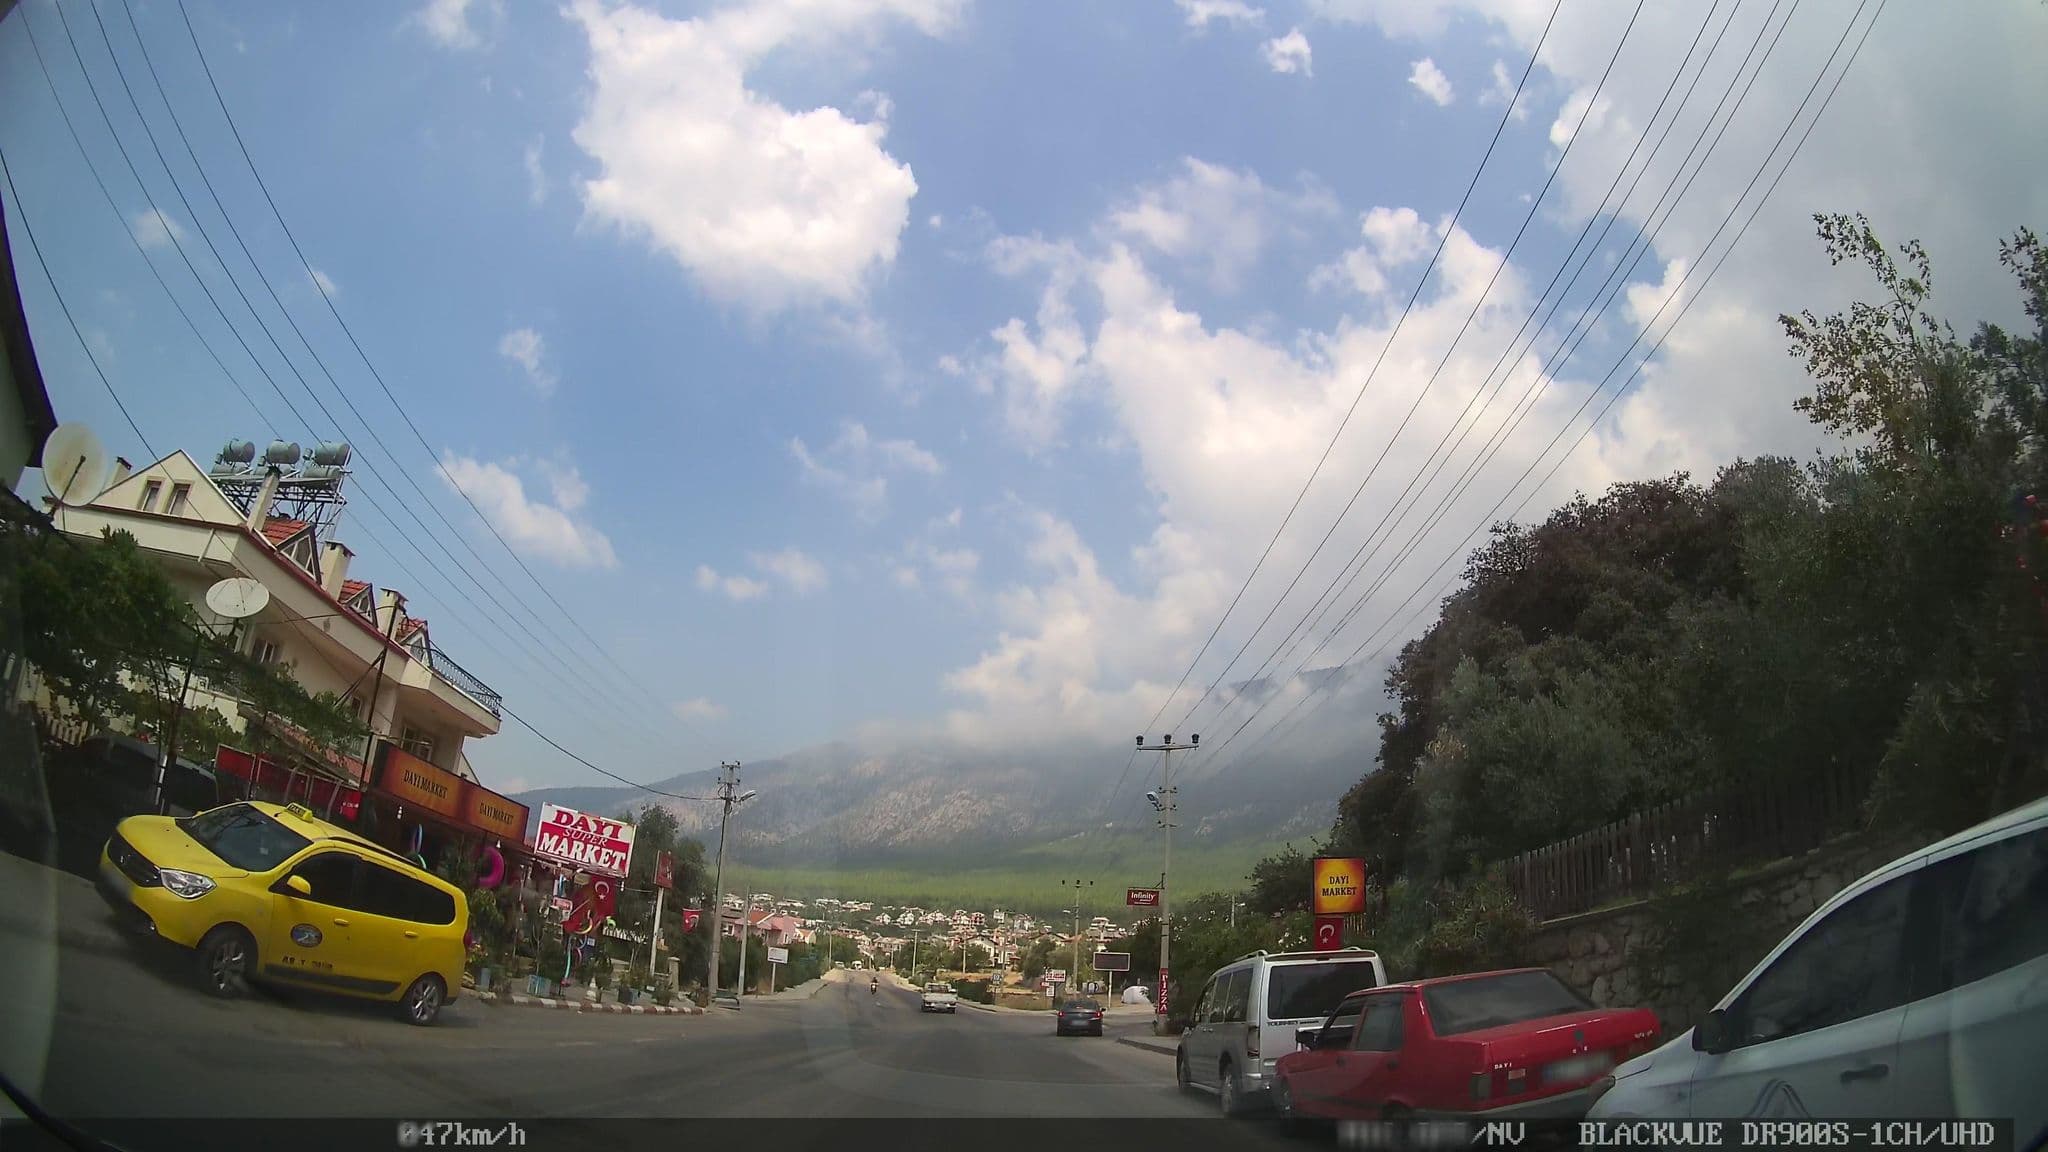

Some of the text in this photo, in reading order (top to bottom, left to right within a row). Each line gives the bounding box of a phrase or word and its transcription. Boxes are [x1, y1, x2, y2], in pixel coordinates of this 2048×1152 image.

[420, 776, 448, 799] MARKET
[493, 807, 514, 825] MARKET
[553, 810, 622, 839] DAYI
[563, 828, 608, 846] SUPER
[539, 832, 627, 870] MARKET
[1329, 875, 1349, 885] DAYI
[1131, 892, 1156, 901] Infinity
[1322, 887, 1357, 896] MARKET
[1160, 974, 1168, 1011] PIZZA
